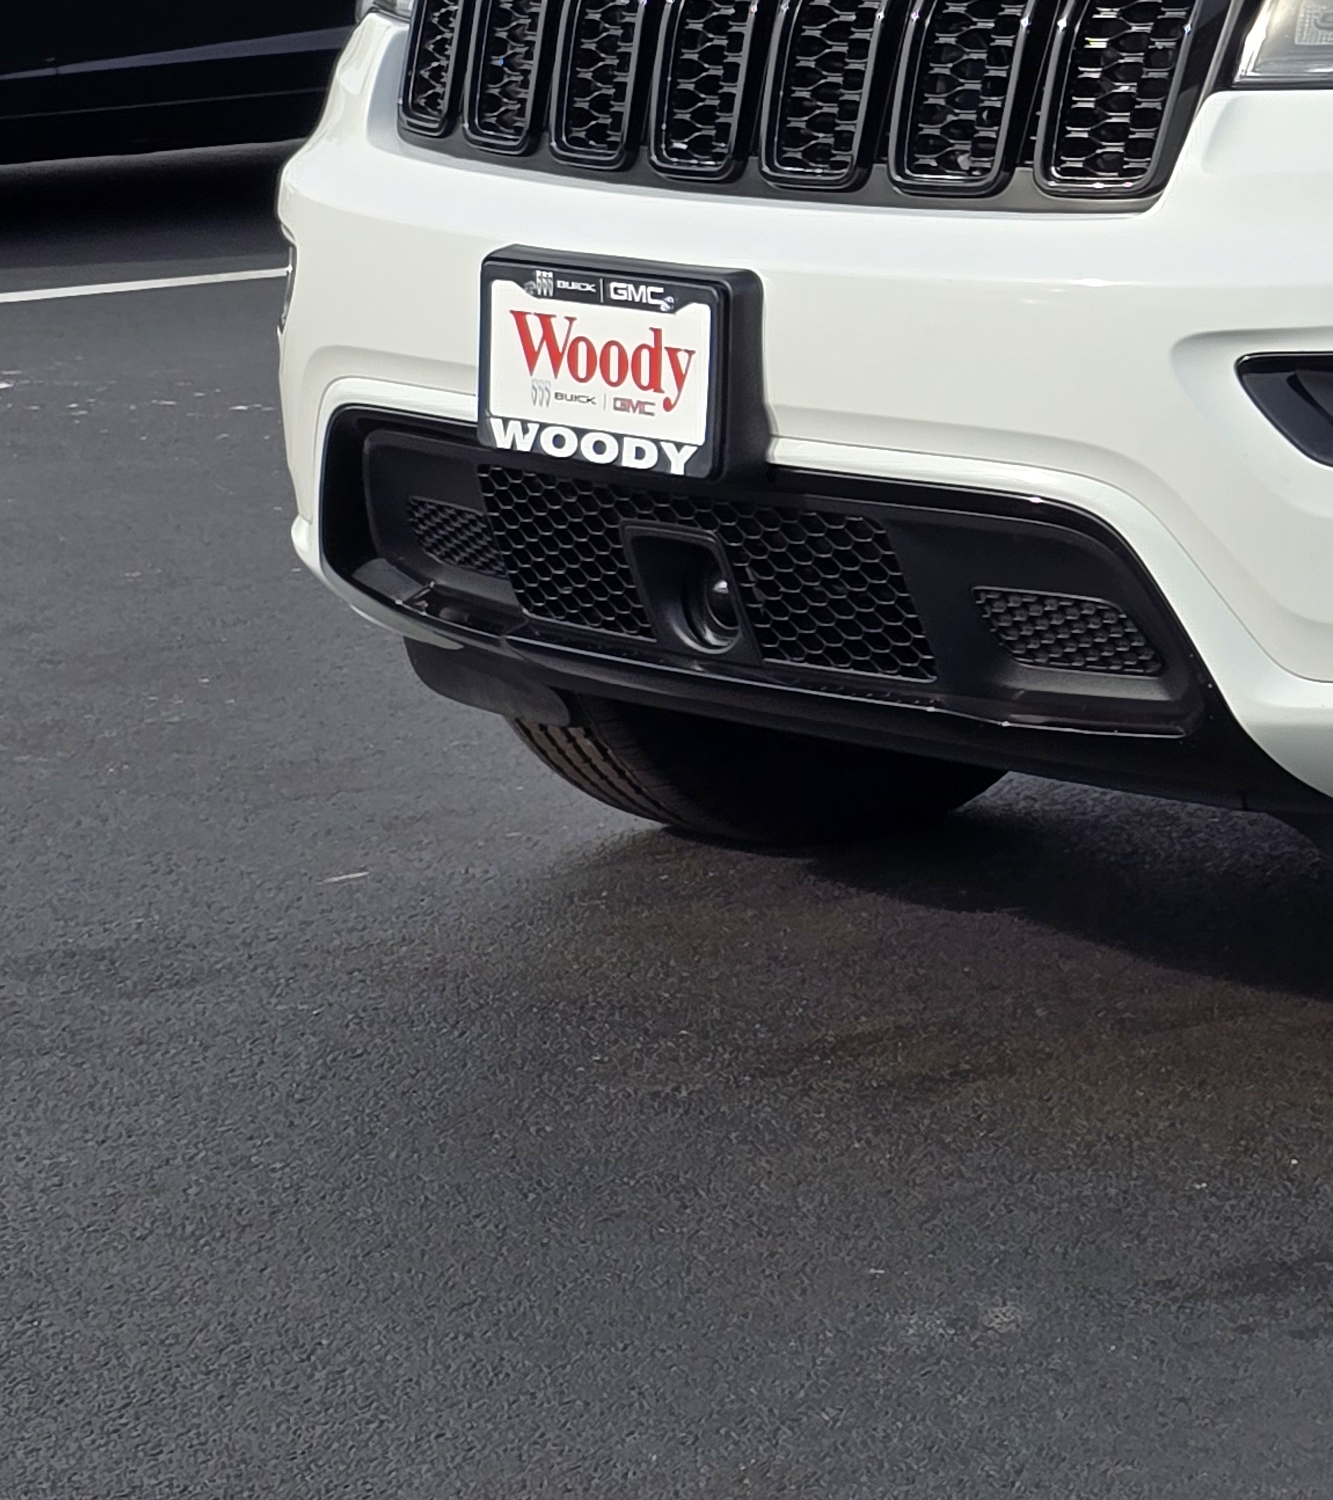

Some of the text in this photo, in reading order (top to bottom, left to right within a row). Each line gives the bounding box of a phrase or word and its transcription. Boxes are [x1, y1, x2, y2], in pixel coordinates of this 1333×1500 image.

[556, 280, 665, 305] BUICK GMC
[509, 310, 696, 412] Woody
[554, 392, 656, 416] BUICK GMC
[490, 417, 698, 476] WOODY
